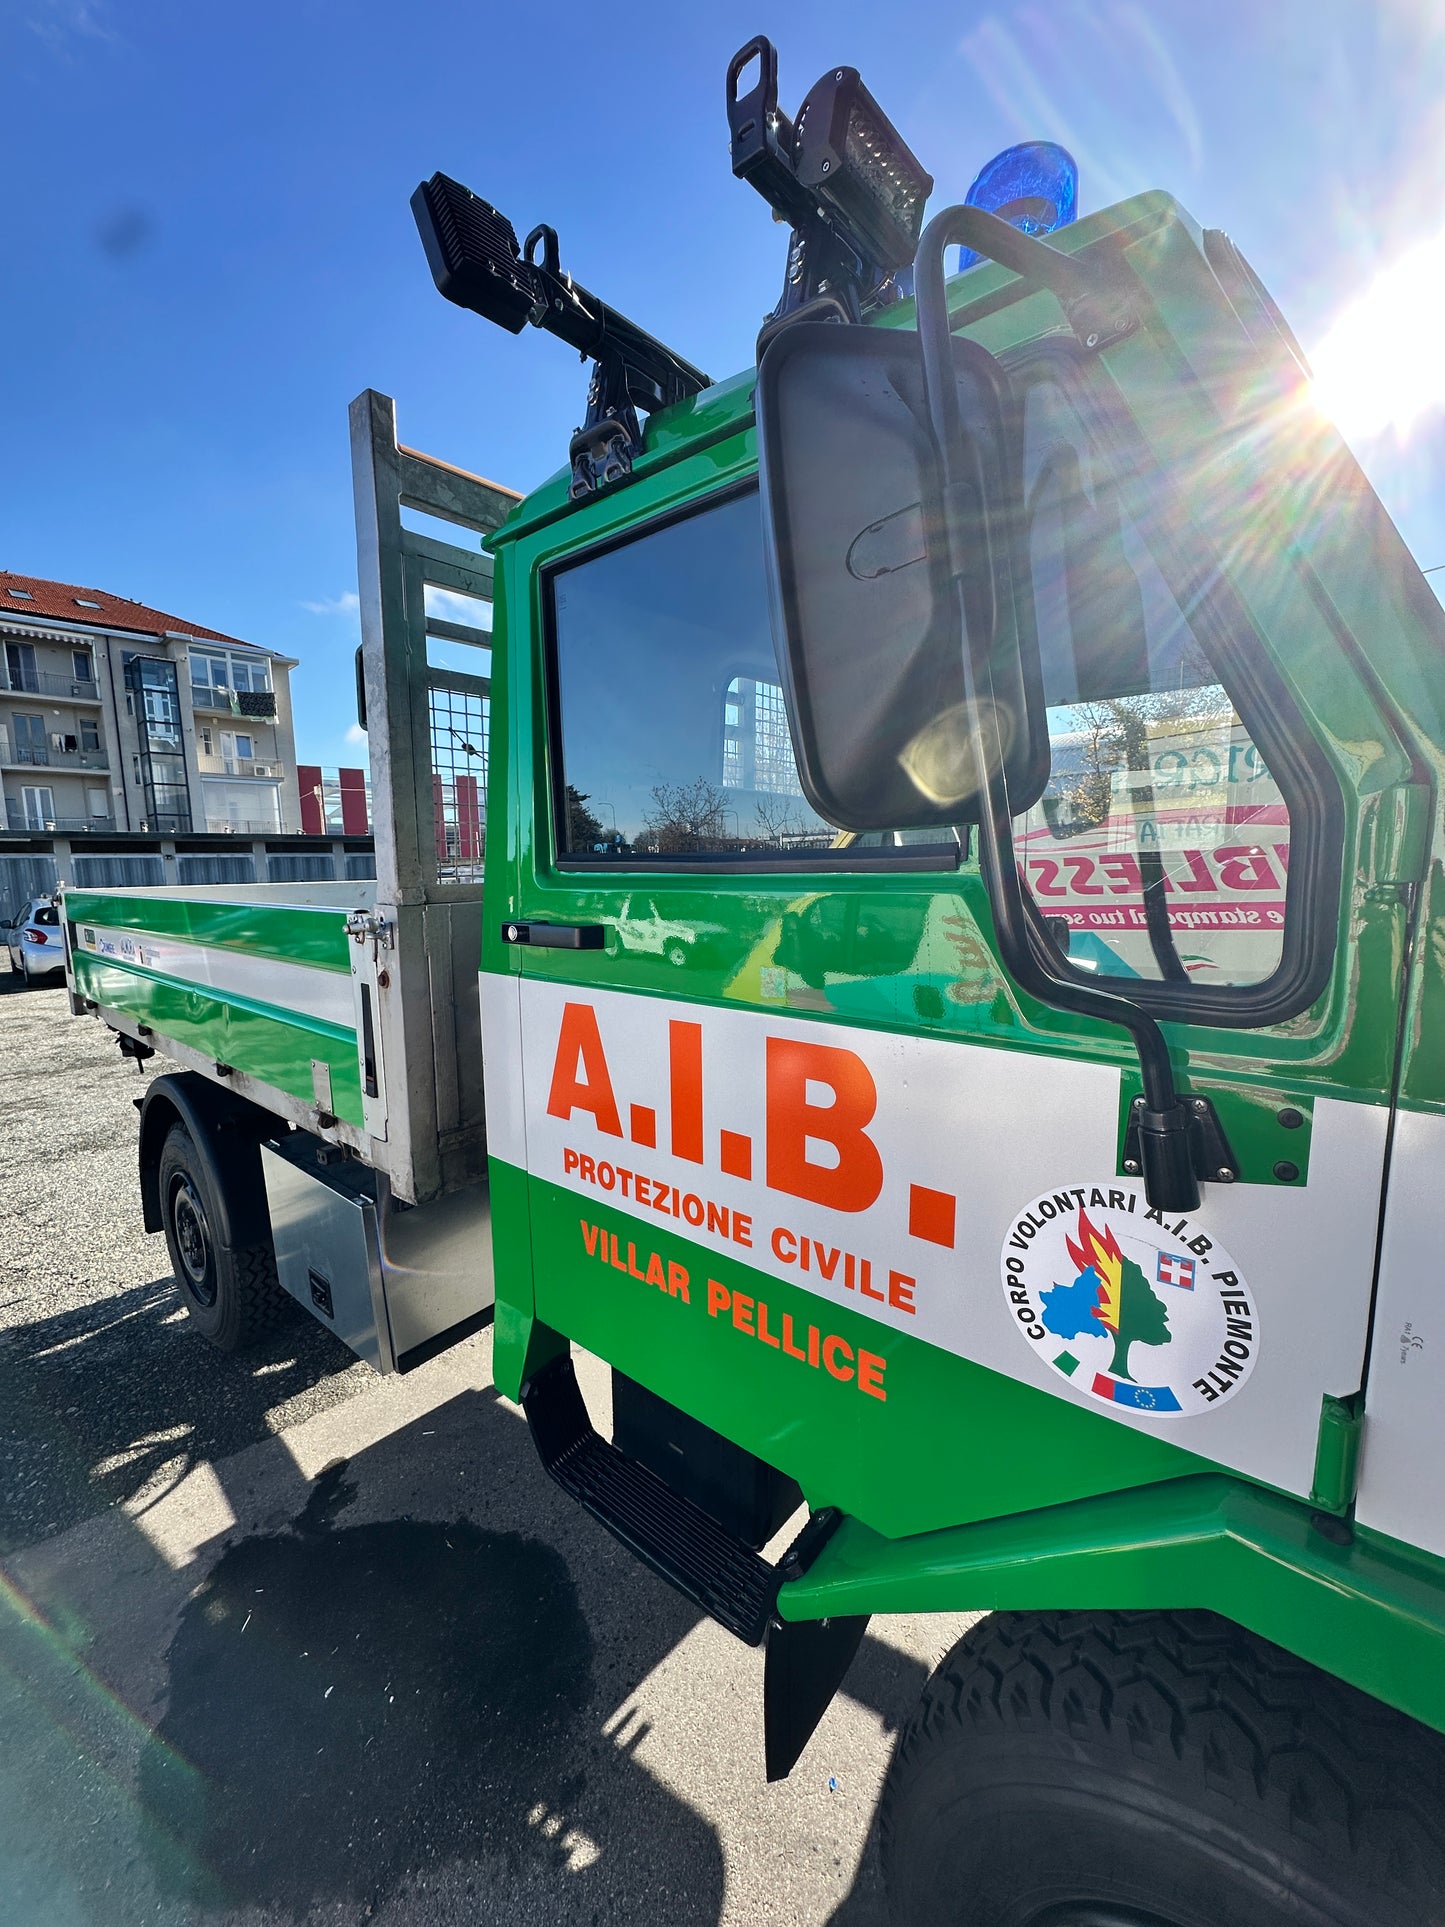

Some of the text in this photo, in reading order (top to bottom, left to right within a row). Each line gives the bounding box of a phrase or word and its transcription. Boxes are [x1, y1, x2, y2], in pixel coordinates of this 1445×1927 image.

[546, 1001, 957, 1249] A.I.B.
[563, 1147, 917, 1315] PROTEZIONE CIVILE
[580, 1219, 888, 1403] VILLAR PELLICE
[1005, 1188, 1253, 1403] CORPO VOLONTARI A.I.B. PIEMONTE
